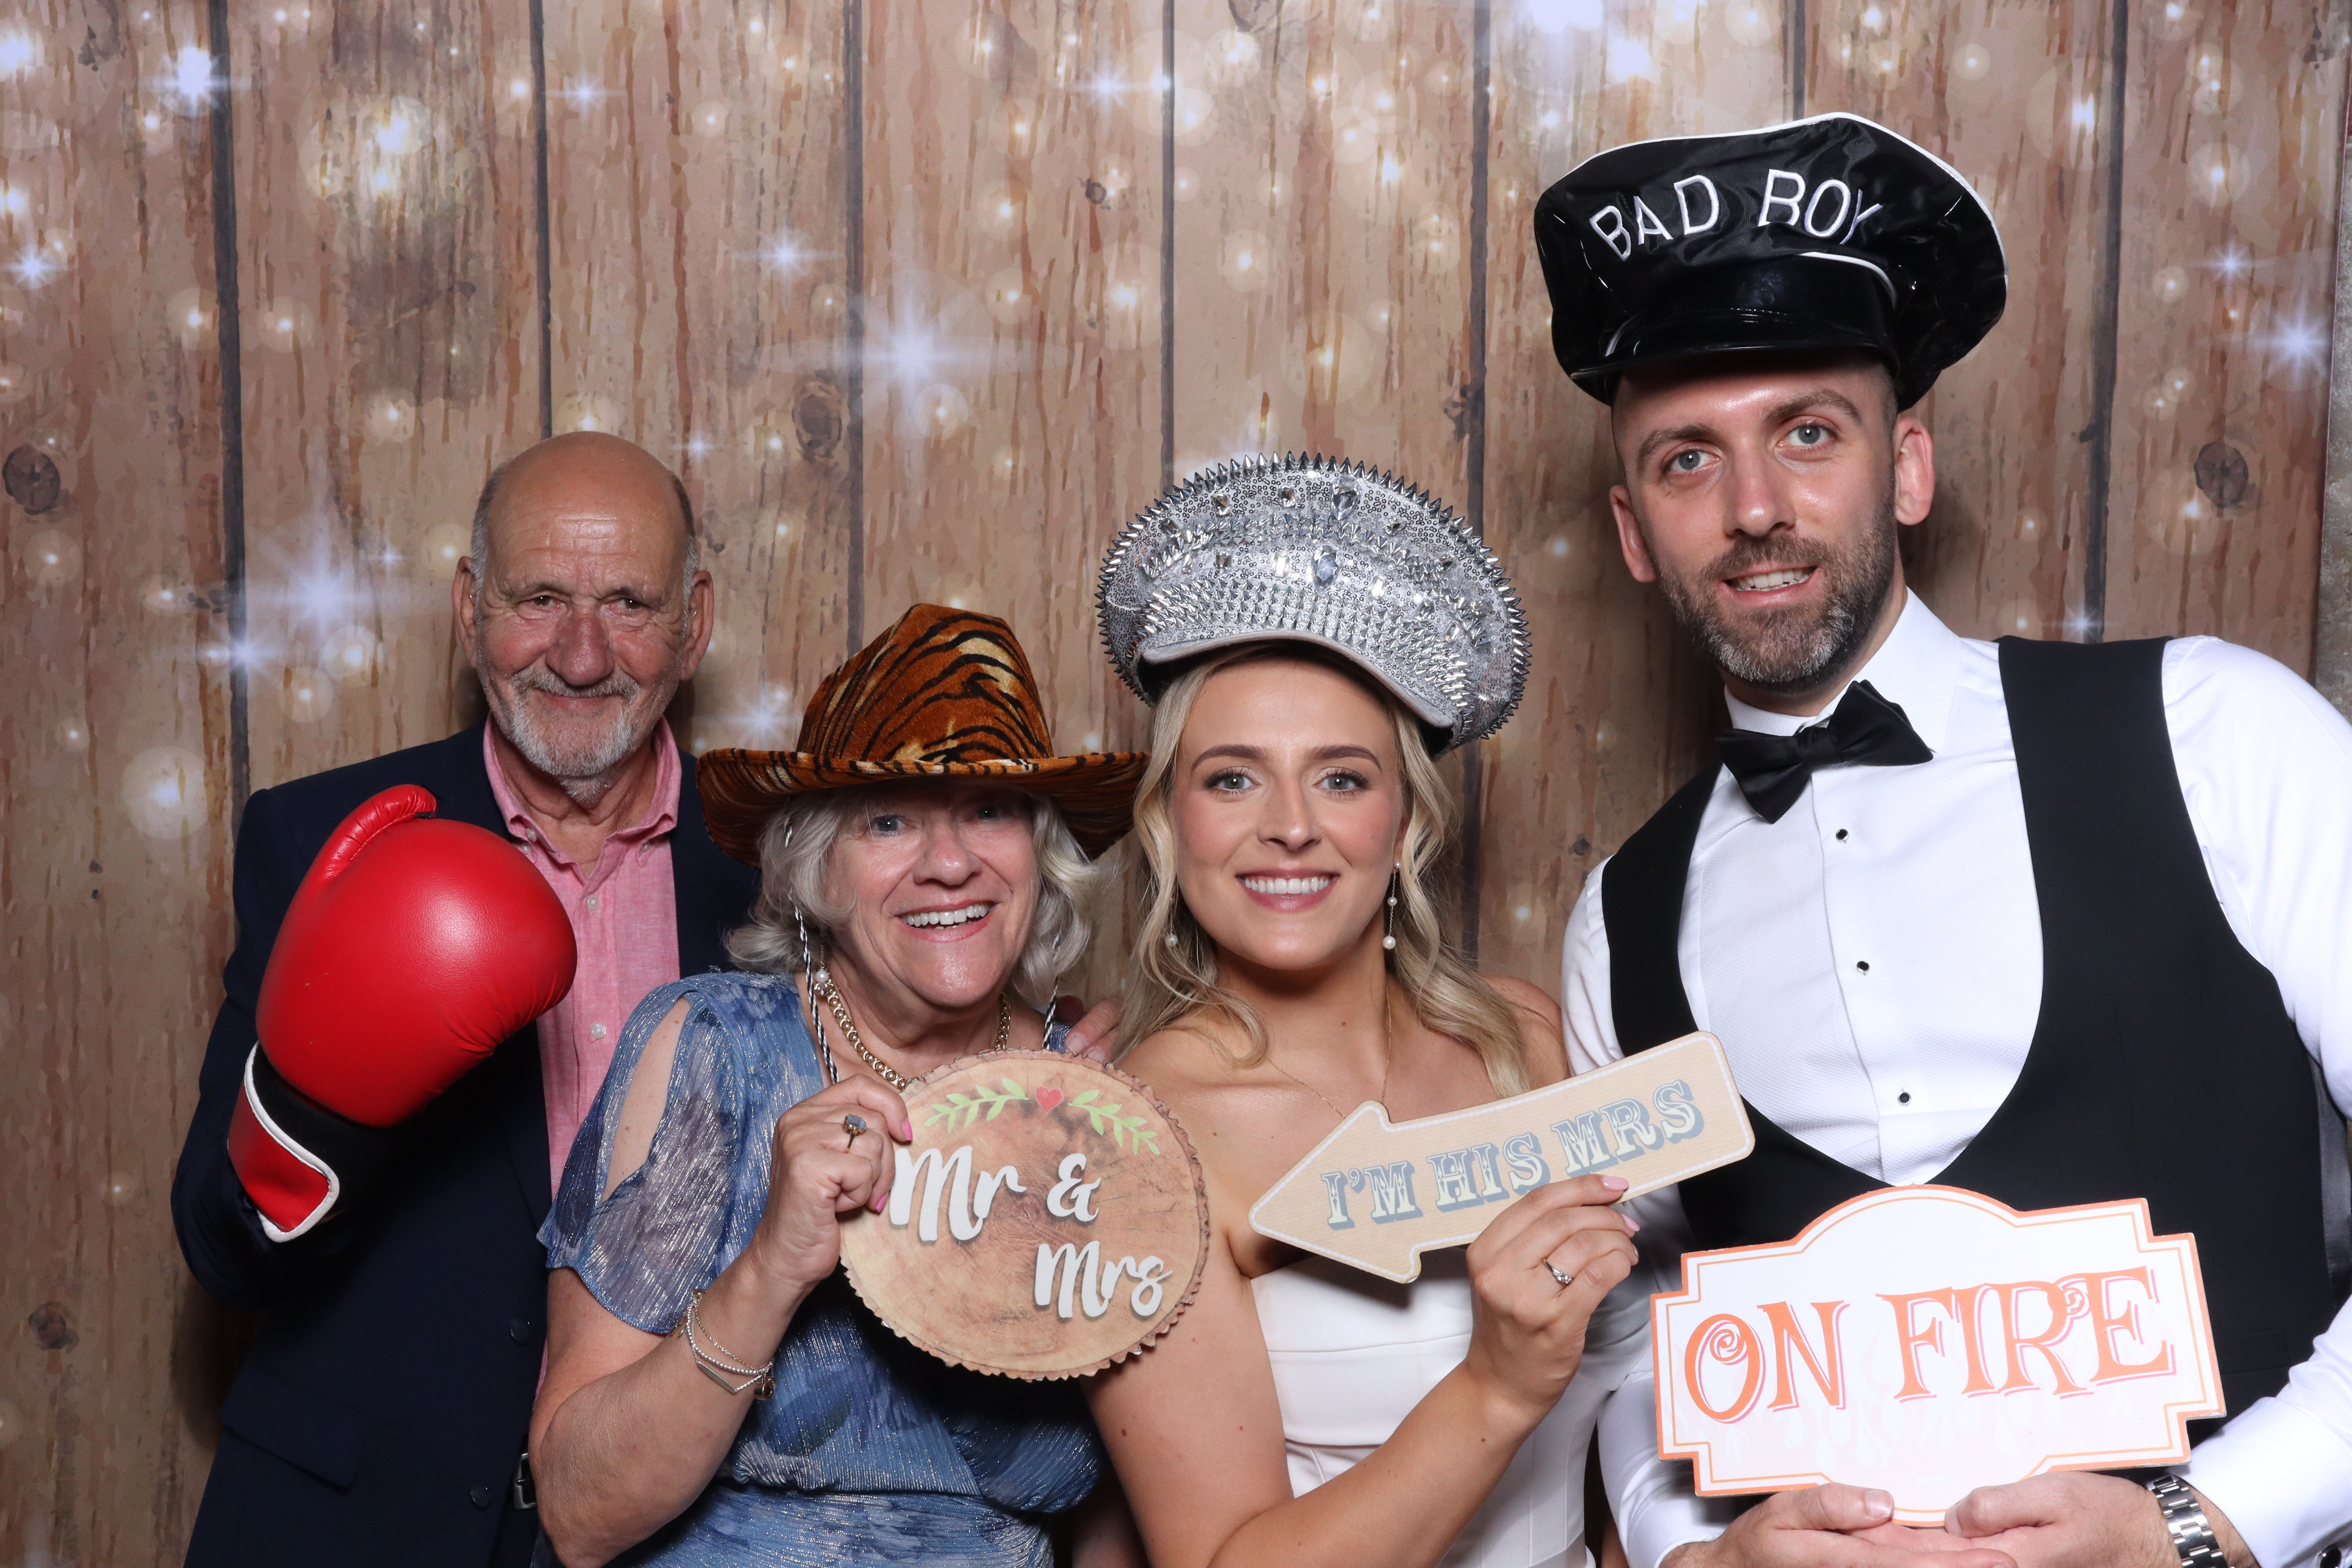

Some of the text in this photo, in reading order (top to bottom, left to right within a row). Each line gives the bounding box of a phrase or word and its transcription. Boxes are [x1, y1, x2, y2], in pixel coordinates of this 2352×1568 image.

[1590, 169, 1882, 261] BAD BOY
[889, 1145, 1101, 1241] Mr &
[1320, 1079, 1704, 1230] I'M HIS MRS
[1035, 1240, 1173, 1318] Mrs
[1684, 1266, 2176, 1423] ON FIRE
